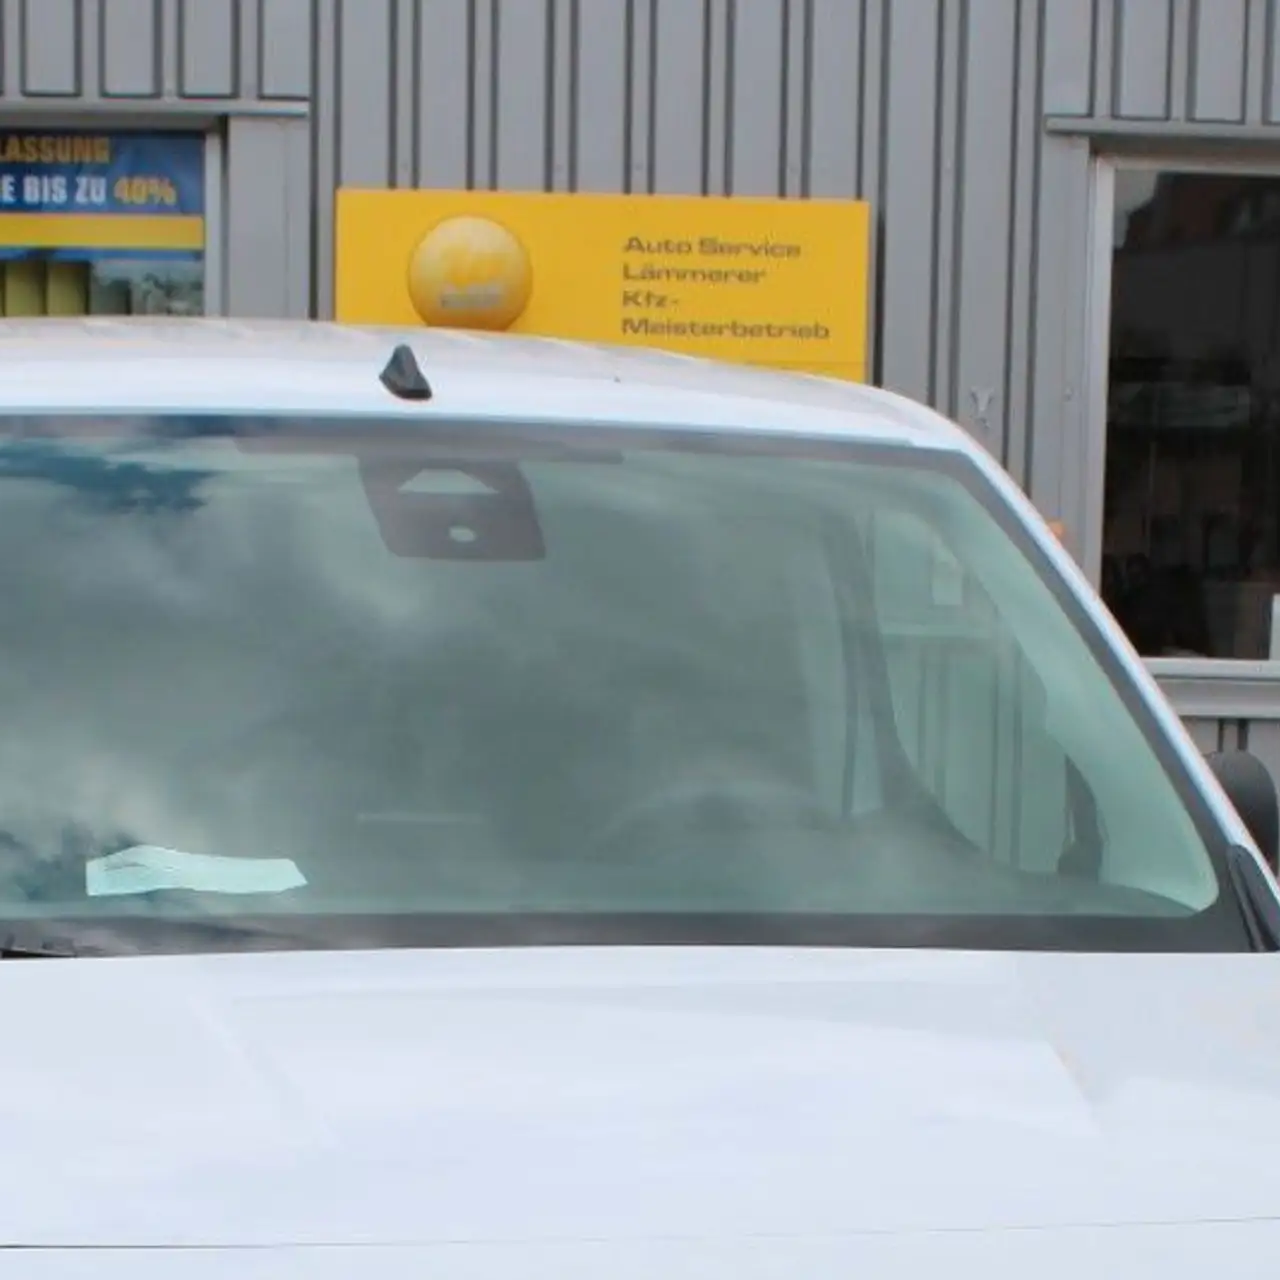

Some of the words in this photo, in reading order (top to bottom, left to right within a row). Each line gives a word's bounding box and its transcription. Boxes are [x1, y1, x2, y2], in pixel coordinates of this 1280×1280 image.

[23, 175, 68, 205] BIS
[75, 176, 108, 206] ZU
[624, 236, 692, 255] Auto
[698, 237, 802, 259] Service
[622, 290, 679, 309] Kfz-
[621, 318, 831, 340] Meisterbetrieb
